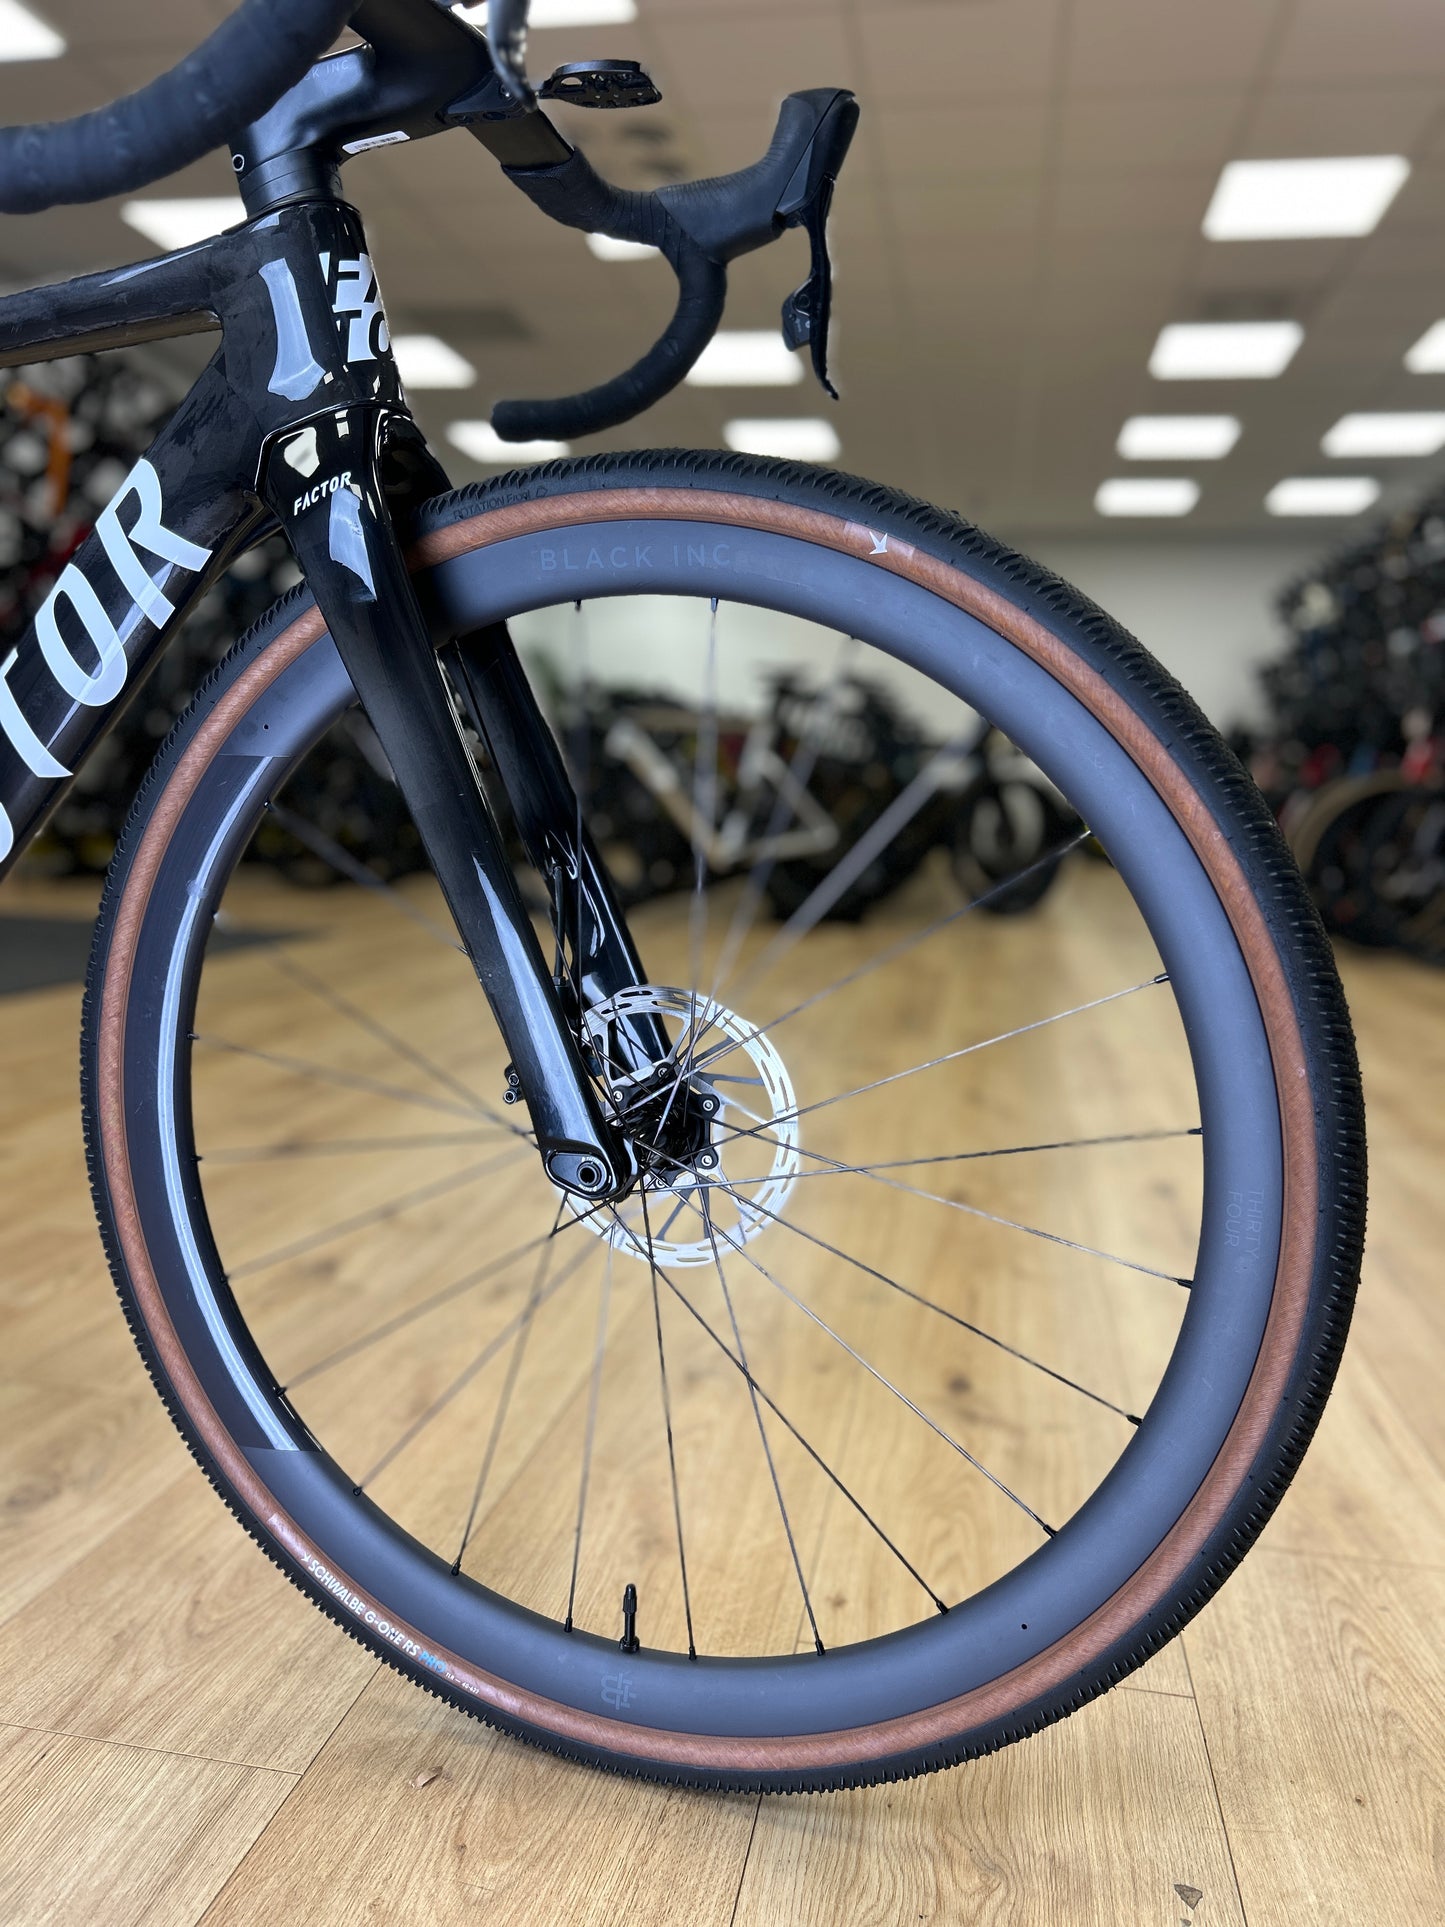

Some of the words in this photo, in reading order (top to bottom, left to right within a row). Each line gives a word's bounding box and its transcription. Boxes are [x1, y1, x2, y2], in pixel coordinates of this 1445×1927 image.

[293, 471, 352, 516] FACTOR
[539, 545, 653, 571] BLACK
[673, 543, 731, 568] INC
[0, 458, 213, 864] TOR
[1224, 1191, 1243, 1247] FOUR
[1244, 1188, 1265, 1260] THIRTY
[308, 1559, 366, 1615] SCHWALBE
[364, 1610, 405, 1646] G-ONE
[402, 1639, 420, 1656] RS
